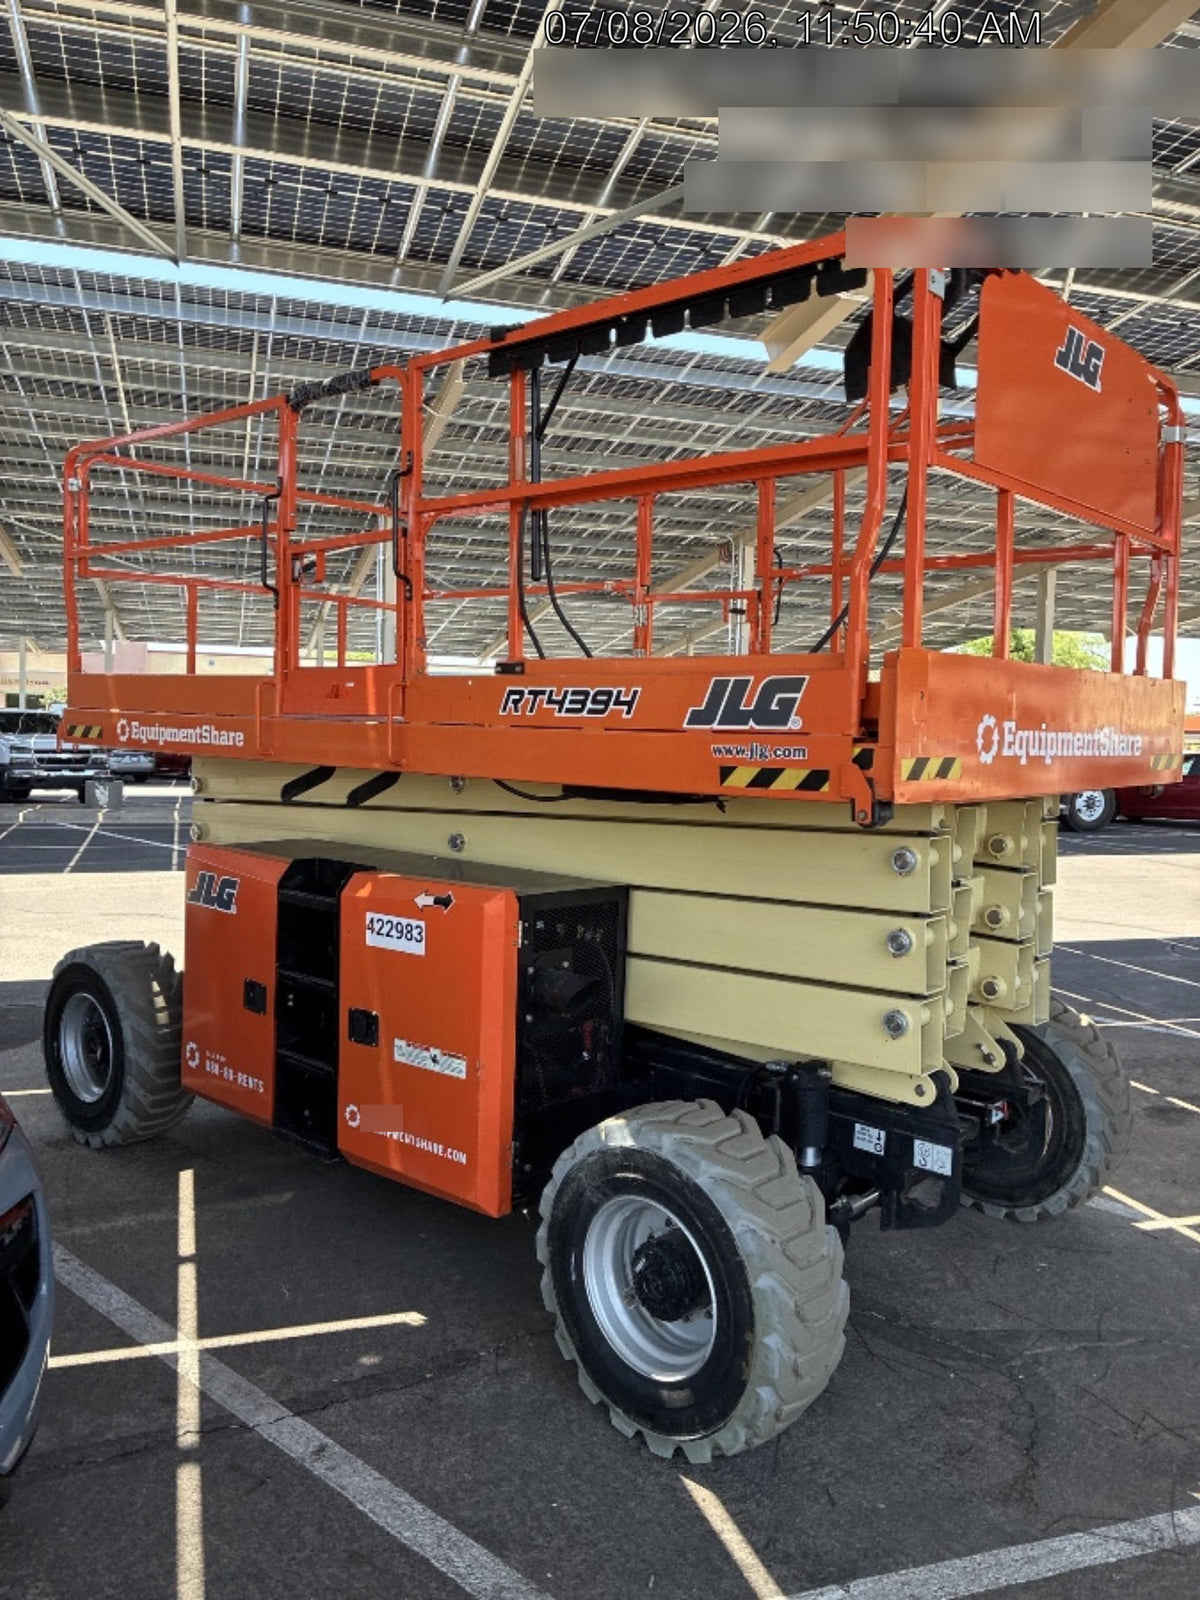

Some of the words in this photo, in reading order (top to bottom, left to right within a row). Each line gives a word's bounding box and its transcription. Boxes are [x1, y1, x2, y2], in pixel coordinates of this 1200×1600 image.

[500, 687, 642, 718] RT4394
[131, 721, 244, 747] EquipmentShare
[1002, 721, 1142, 765] EquipmentShare
[711, 743, 807, 760] www.jlg.com
[367, 916, 424, 943] 422983
